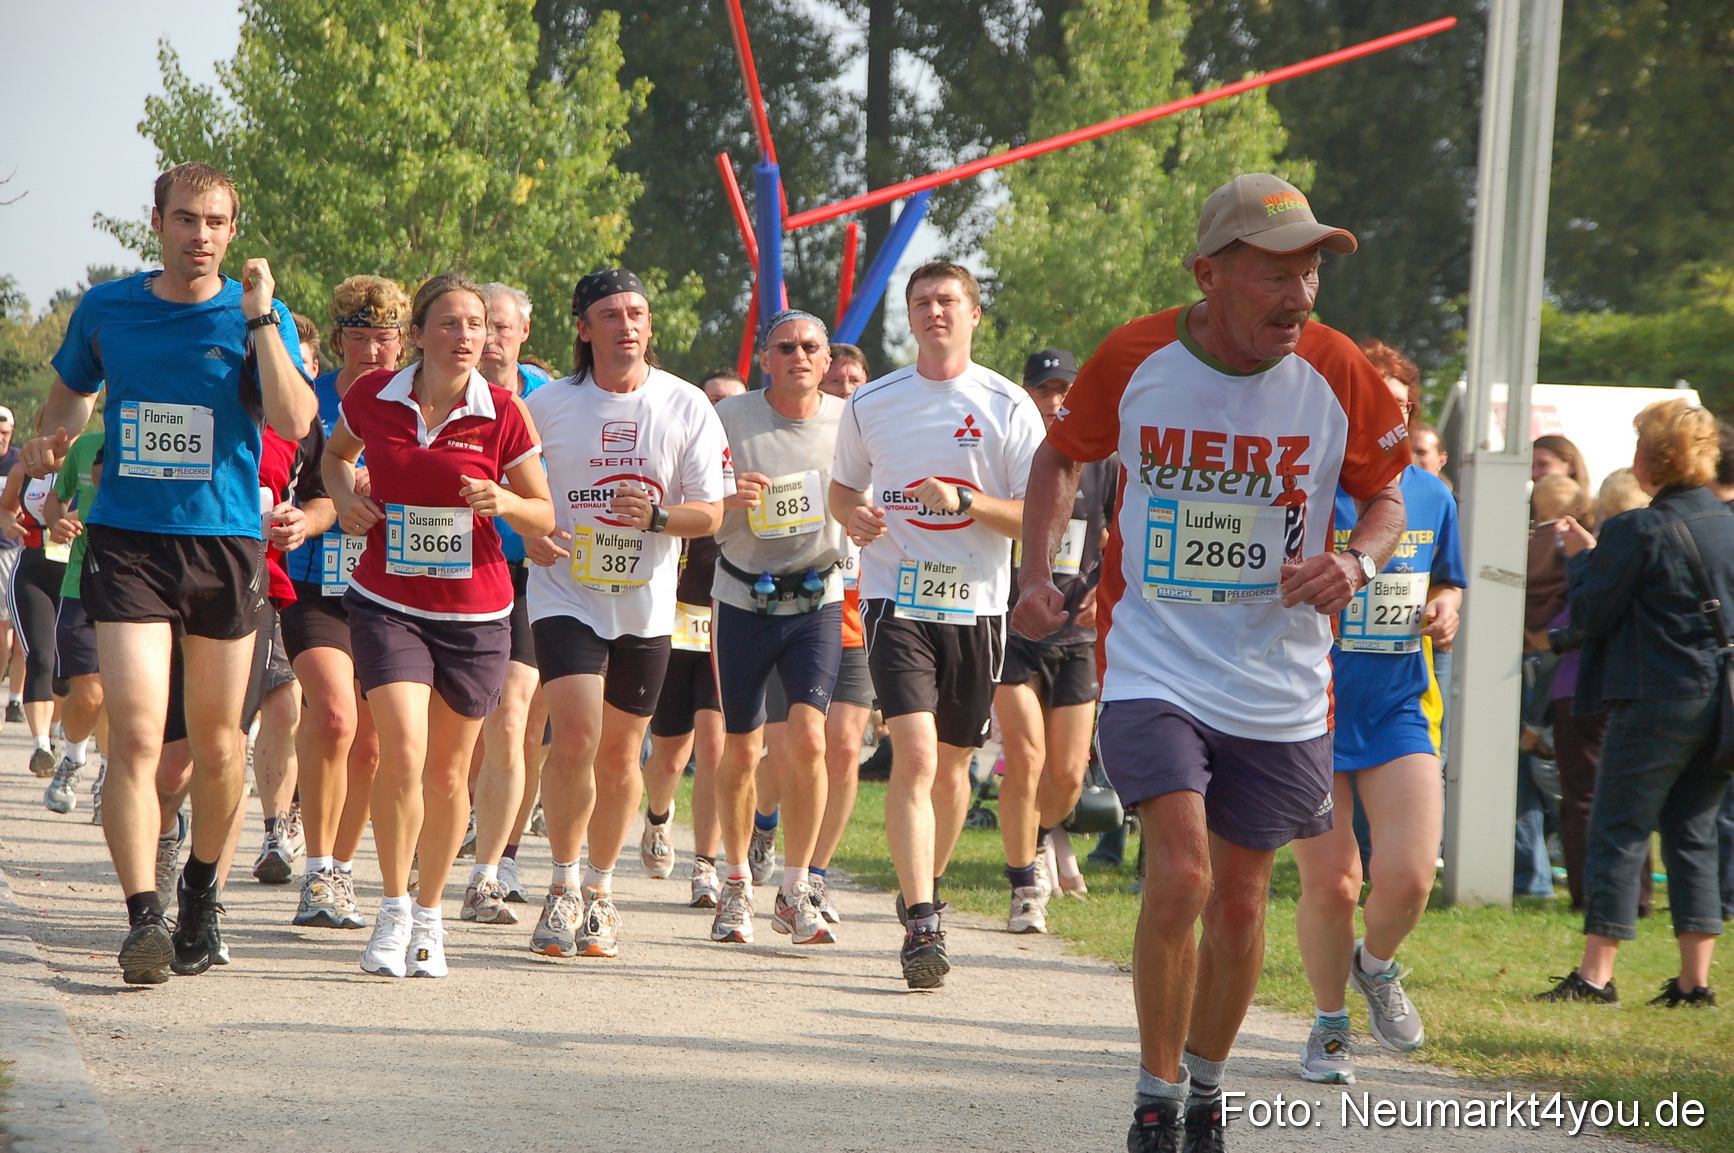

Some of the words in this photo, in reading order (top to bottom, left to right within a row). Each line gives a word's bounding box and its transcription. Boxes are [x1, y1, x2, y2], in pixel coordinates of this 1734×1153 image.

[144, 408, 184, 425] Florian
[125, 428, 131, 439] B
[145, 431, 202, 453] 3665
[1140, 425, 1311, 476] MERZ
[589, 457, 648, 467] SEAT
[1139, 451, 1273, 498] Reisen
[776, 496, 810, 517] 883
[409, 512, 454, 527] Susanne
[1185, 509, 1242, 534] Ludwig
[391, 529, 397, 539] B
[410, 533, 462, 552] 3666
[595, 532, 643, 551] Wolfgang
[1155, 534, 1163, 548] D
[346, 538, 363, 550] Eva
[1184, 539, 1267, 570] 2869
[601, 553, 640, 574] 387
[924, 560, 957, 574] Walter
[904, 575, 910, 586] C
[1374, 580, 1411, 597] Bärbel
[922, 579, 970, 600] 2416
[1227, 588, 1277, 598] PFLEIDERER
[1352, 602, 1358, 614] D
[1374, 604, 1422, 626] 2275
